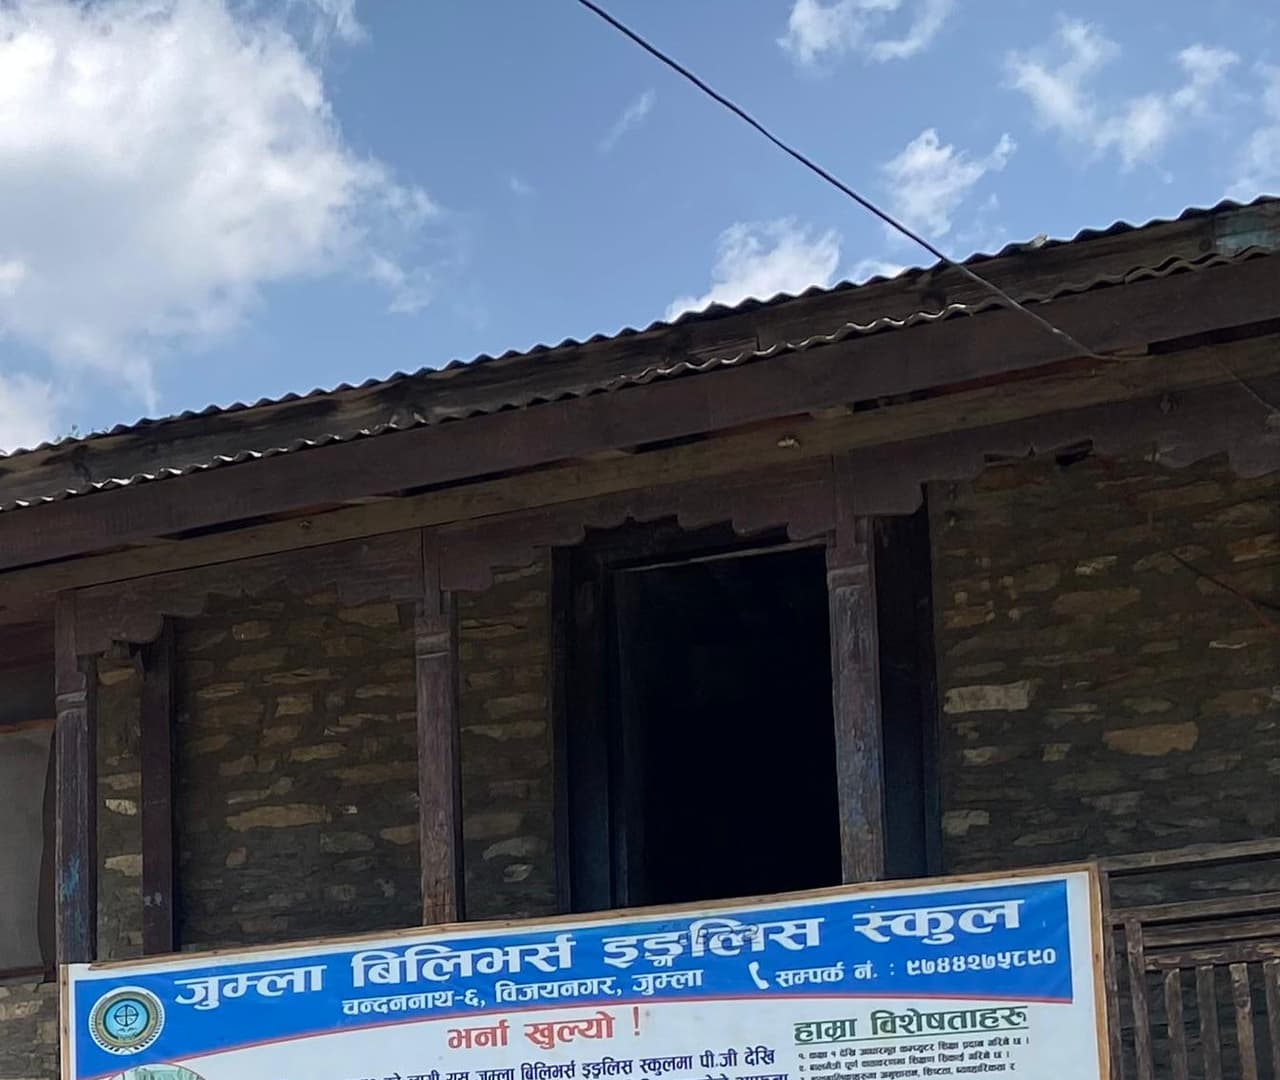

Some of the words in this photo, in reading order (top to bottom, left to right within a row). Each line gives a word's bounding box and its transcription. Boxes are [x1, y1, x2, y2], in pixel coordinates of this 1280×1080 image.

[172, 964, 329, 1011] जुम्ला
[350, 932, 577, 989] बिलिभर्स
[851, 899, 1025, 947] स्कुल
[775, 961, 845, 988] सम्पर्क
[853, 960, 878, 980] नं.
[906, 948, 1057, 976] ९७४४२७५८९०
[341, 987, 487, 1017] चन्दननाथ-६,
[494, 975, 624, 1003] विजयनगर,
[630, 968, 705, 997] जुम्ला
[446, 1018, 511, 1049] भर्ना
[523, 1010, 616, 1051] खुल्यो
[632, 1005, 641, 1037] !
[792, 1018, 858, 1043] हाम्रा
[639, 1054, 693, 1076] स्कुलमा
[744, 1045, 776, 1067] देखि
